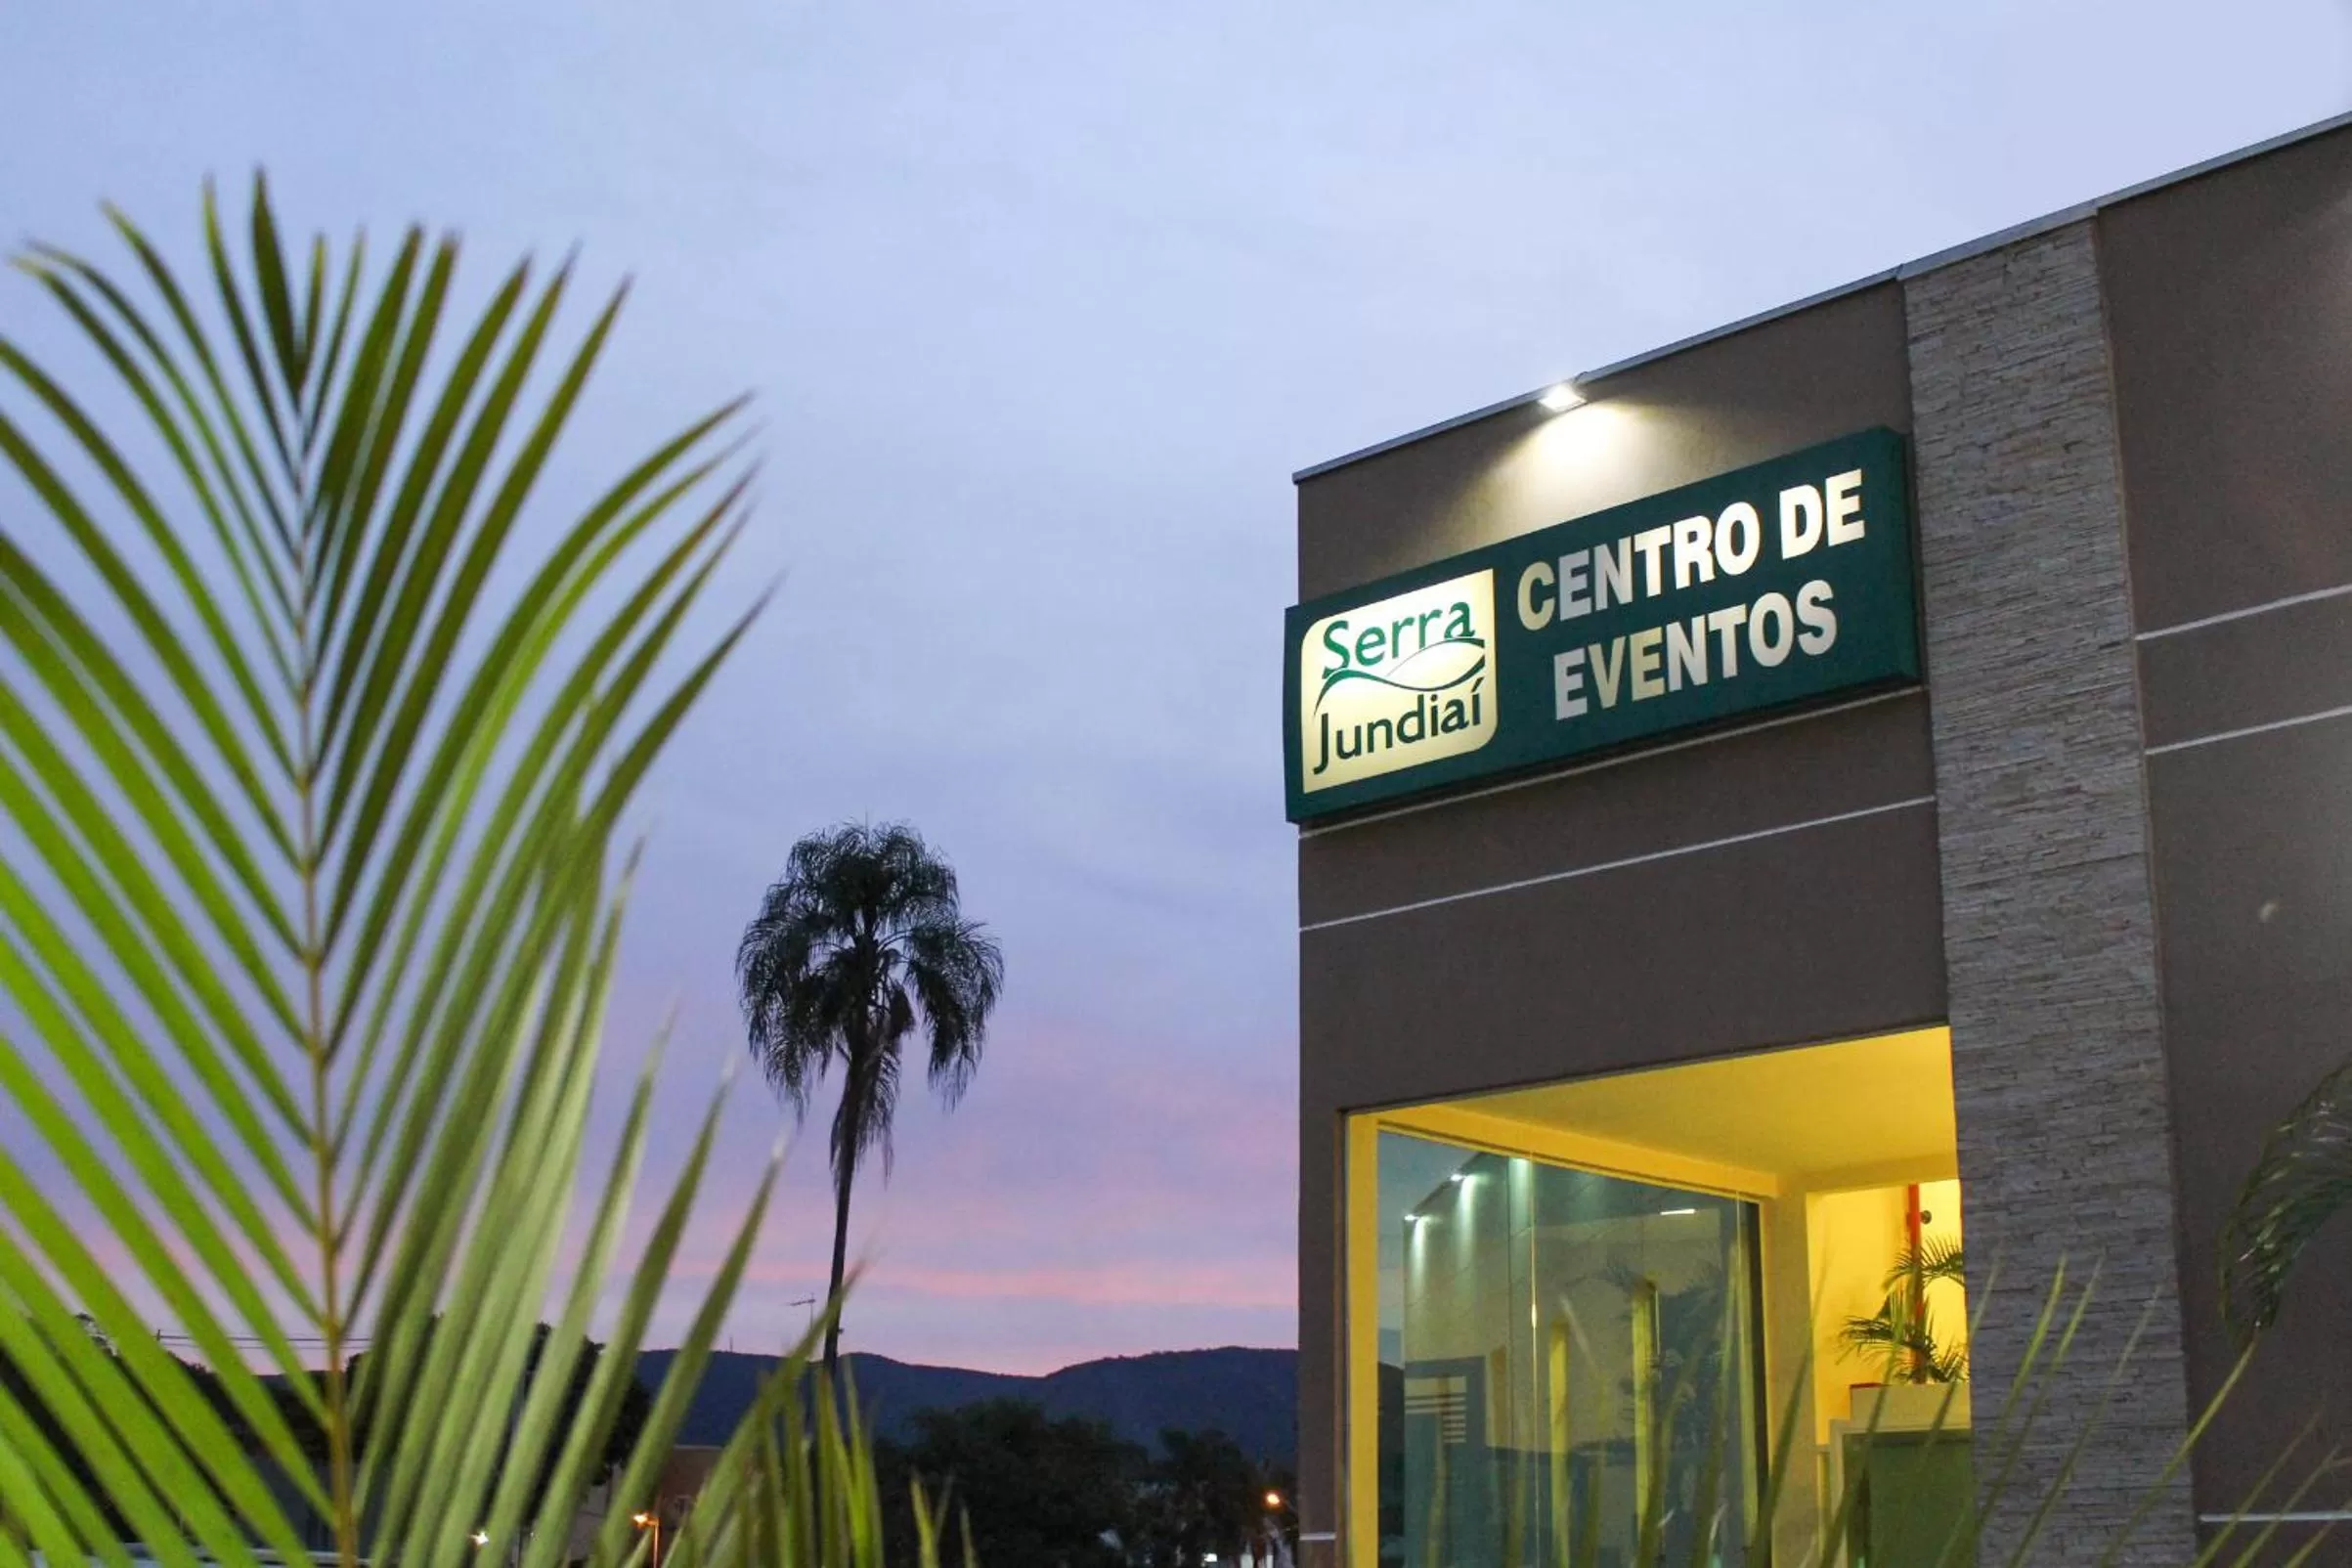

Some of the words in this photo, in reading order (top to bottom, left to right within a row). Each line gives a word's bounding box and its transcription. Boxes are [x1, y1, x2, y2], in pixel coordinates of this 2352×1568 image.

[1516, 501, 1761, 632] CENTRO
[1778, 467, 1866, 561] DE
[1322, 600, 1477, 679] Serra
[1553, 579, 1838, 721] EVENTOS
[1312, 677, 1483, 775] Jundiaí
